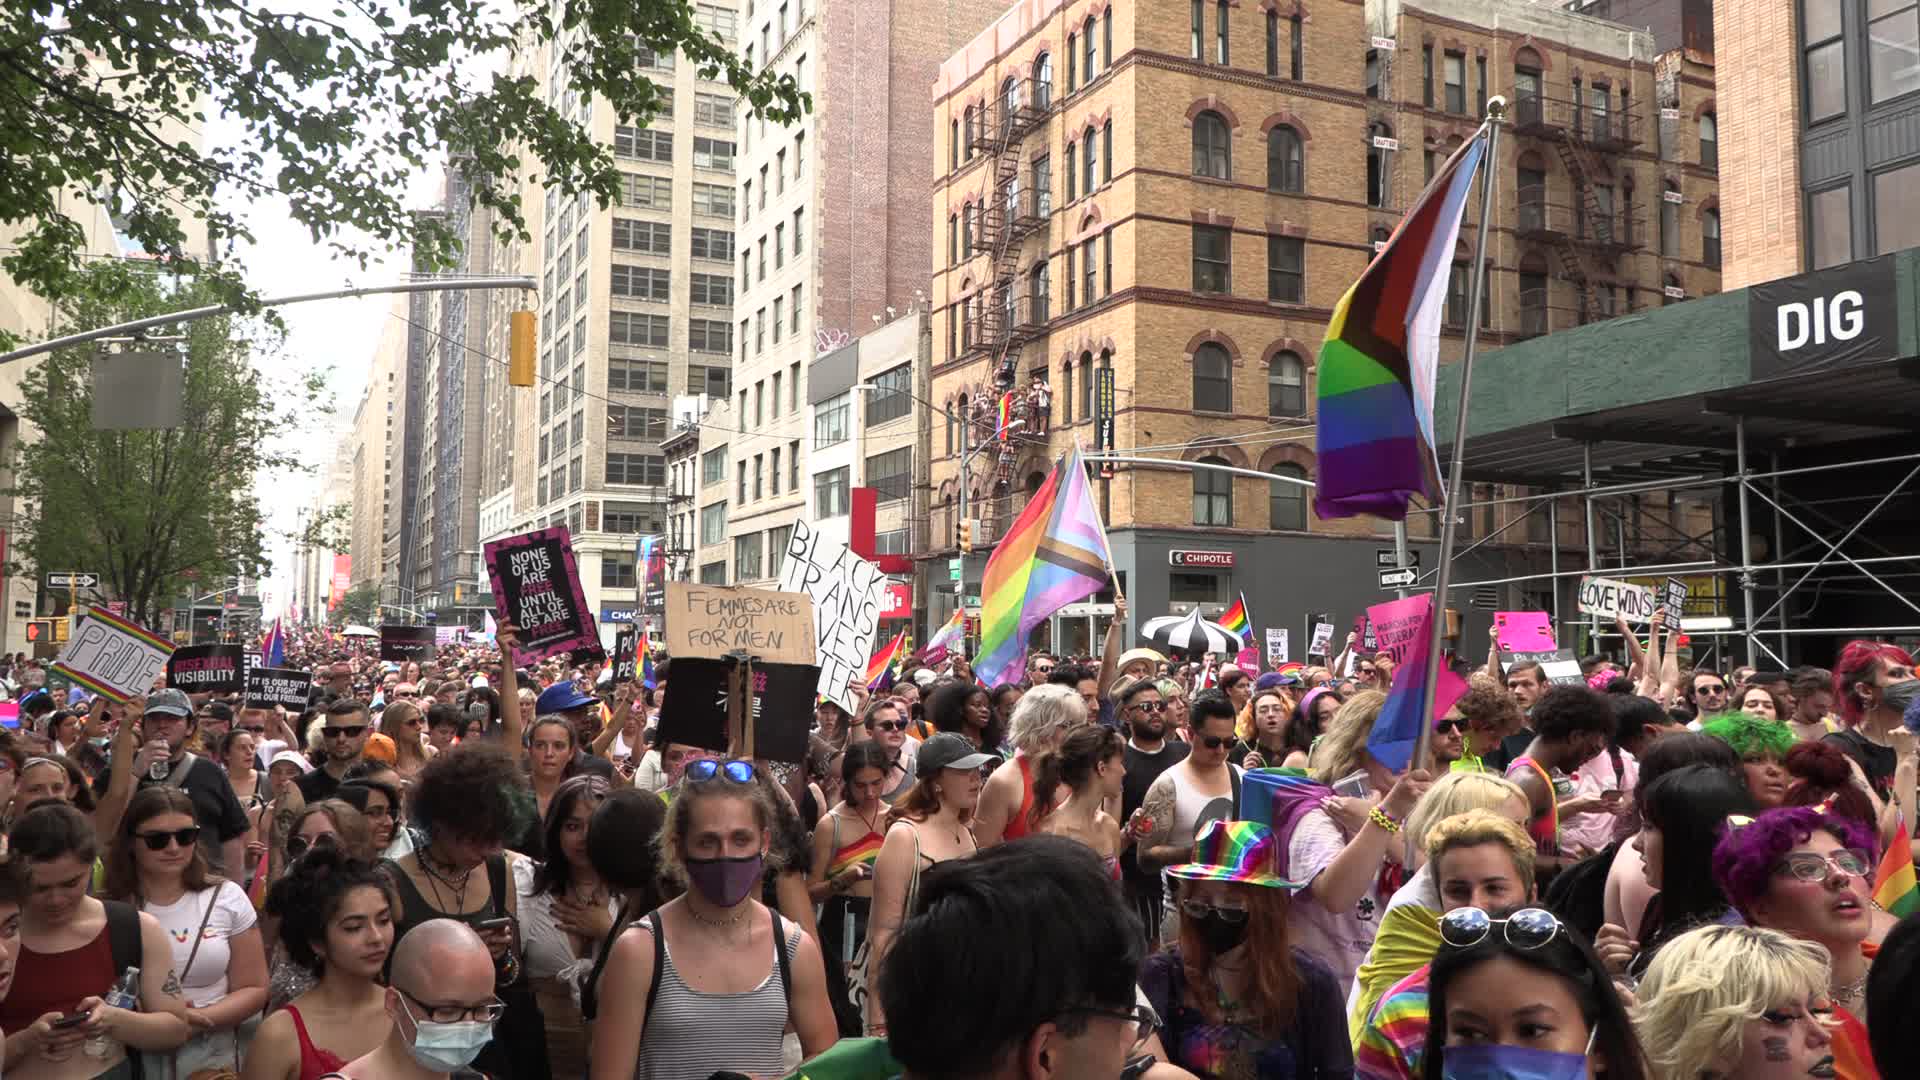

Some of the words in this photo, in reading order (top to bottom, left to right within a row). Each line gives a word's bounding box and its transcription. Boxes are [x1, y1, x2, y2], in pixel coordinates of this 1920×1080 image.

[1777, 290, 1864, 352] DIG
[511, 547, 547, 565] NONE
[788, 518, 884, 602] BLACK
[1186, 554, 1232, 563] CHIPOTLE
[511, 562, 529, 576] OF
[532, 558, 551, 572] US
[521, 570, 548, 586] ARE
[521, 581, 553, 596] FREE
[788, 551, 876, 635] TRANS
[519, 591, 561, 608] UNTIL
[1580, 581, 1615, 611] LOVE
[1617, 588, 1653, 617] WINS
[520, 606, 545, 620] ALL
[547, 599, 565, 613] OF
[611, 611, 632, 620] CHA
[520, 616, 540, 630] US
[544, 609, 570, 625] ARE
[718, 613, 763, 629] NOT
[531, 621, 566, 638] FREE
[819, 607, 867, 669] VES
[688, 628, 729, 647] FOR
[735, 629, 784, 649] MEN
[66, 624, 162, 694] PRIDE
[174, 656, 235, 672] BISEXUAL
[174, 669, 236, 684] VISIBILITY
[251, 677, 260, 685] IT
[261, 677, 270, 686] IS
[271, 678, 288, 687] OUR
[290, 680, 308, 689] DUTY
[247, 692, 262, 700] FOR
[263, 693, 279, 702] OUR
[280, 694, 308, 704] FREEDOM
[263, 685, 274, 693] TO
[275, 686, 297, 695] FIGHT
